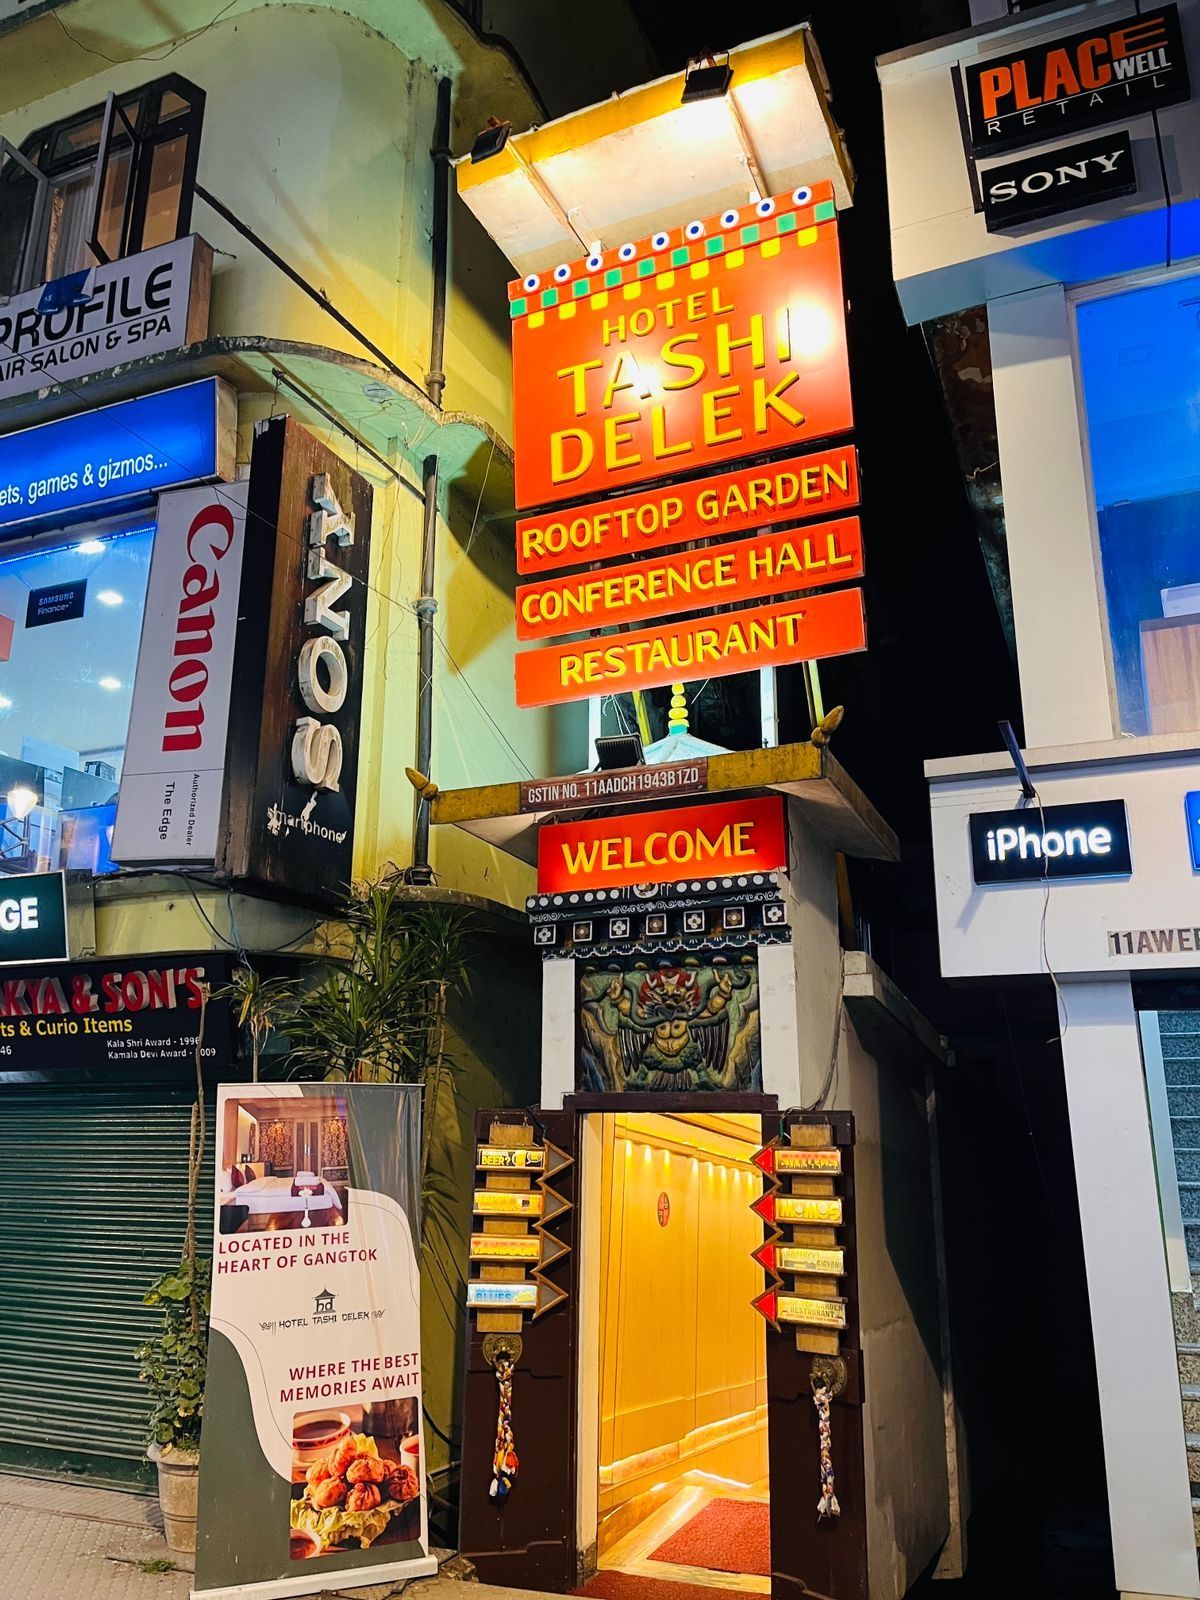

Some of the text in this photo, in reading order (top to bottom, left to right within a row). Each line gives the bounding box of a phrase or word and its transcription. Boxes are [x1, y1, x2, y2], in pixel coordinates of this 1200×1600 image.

[980, 17, 1168, 119] PLACE
[1113, 48, 1171, 80] WELL
[987, 76, 1165, 135] RETAIL
[990, 150, 1124, 203] SONY
[602, 287, 734, 346] HOTEL
[31, 335, 99, 373] SALON
[105, 330, 121, 350] &
[127, 315, 171, 344] SPA
[557, 307, 791, 417] TASHI
[551, 370, 805, 486] DELEK
[28, 473, 78, 504] games
[82, 463, 94, 484] &
[98, 453, 168, 487] gizmos...
[522, 460, 848, 558] ROOFTOP GARDEN
[39, 592, 74, 606] SAMSUNG
[521, 534, 852, 624] CONFERENCE HALL
[162, 504, 234, 752] Canon
[291, 471, 355, 792] SONY
[559, 613, 803, 686] RESTAURANT
[159, 782, 175, 840] The Edge
[186, 774, 200, 846] Authorized Dealer
[528, 767, 699, 803] GSTIN NO. 11AADCH1943B1ZD
[561, 822, 756, 875] WELCOME
[986, 826, 1112, 861] iPhone
[0, 897, 38, 931] GE
[72, 973, 99, 1014] &
[102, 966, 204, 1013] SON'S
[20, 1020, 32, 1036] &
[36, 1018, 78, 1036] Curio
[83, 1017, 133, 1033] Items
[107, 1039, 124, 1048] Kala
[127, 1038, 142, 1047] Shri
[145, 1037, 171, 1046] Award
[108, 1051, 138, 1059] Kamala
[141, 1050, 158, 1058] Devi
[160, 1049, 187, 1058] Award
[218, 1249, 378, 1274] HEART OF GANGTOK
[219, 1232, 350, 1254] LOCATED IN THE
[279, 1312, 370, 1329] HOTEL TASHI DELEK
[280, 1372, 419, 1402] MEMORIES AWAIT
[289, 1353, 419, 1381] WHERE THE BEST
